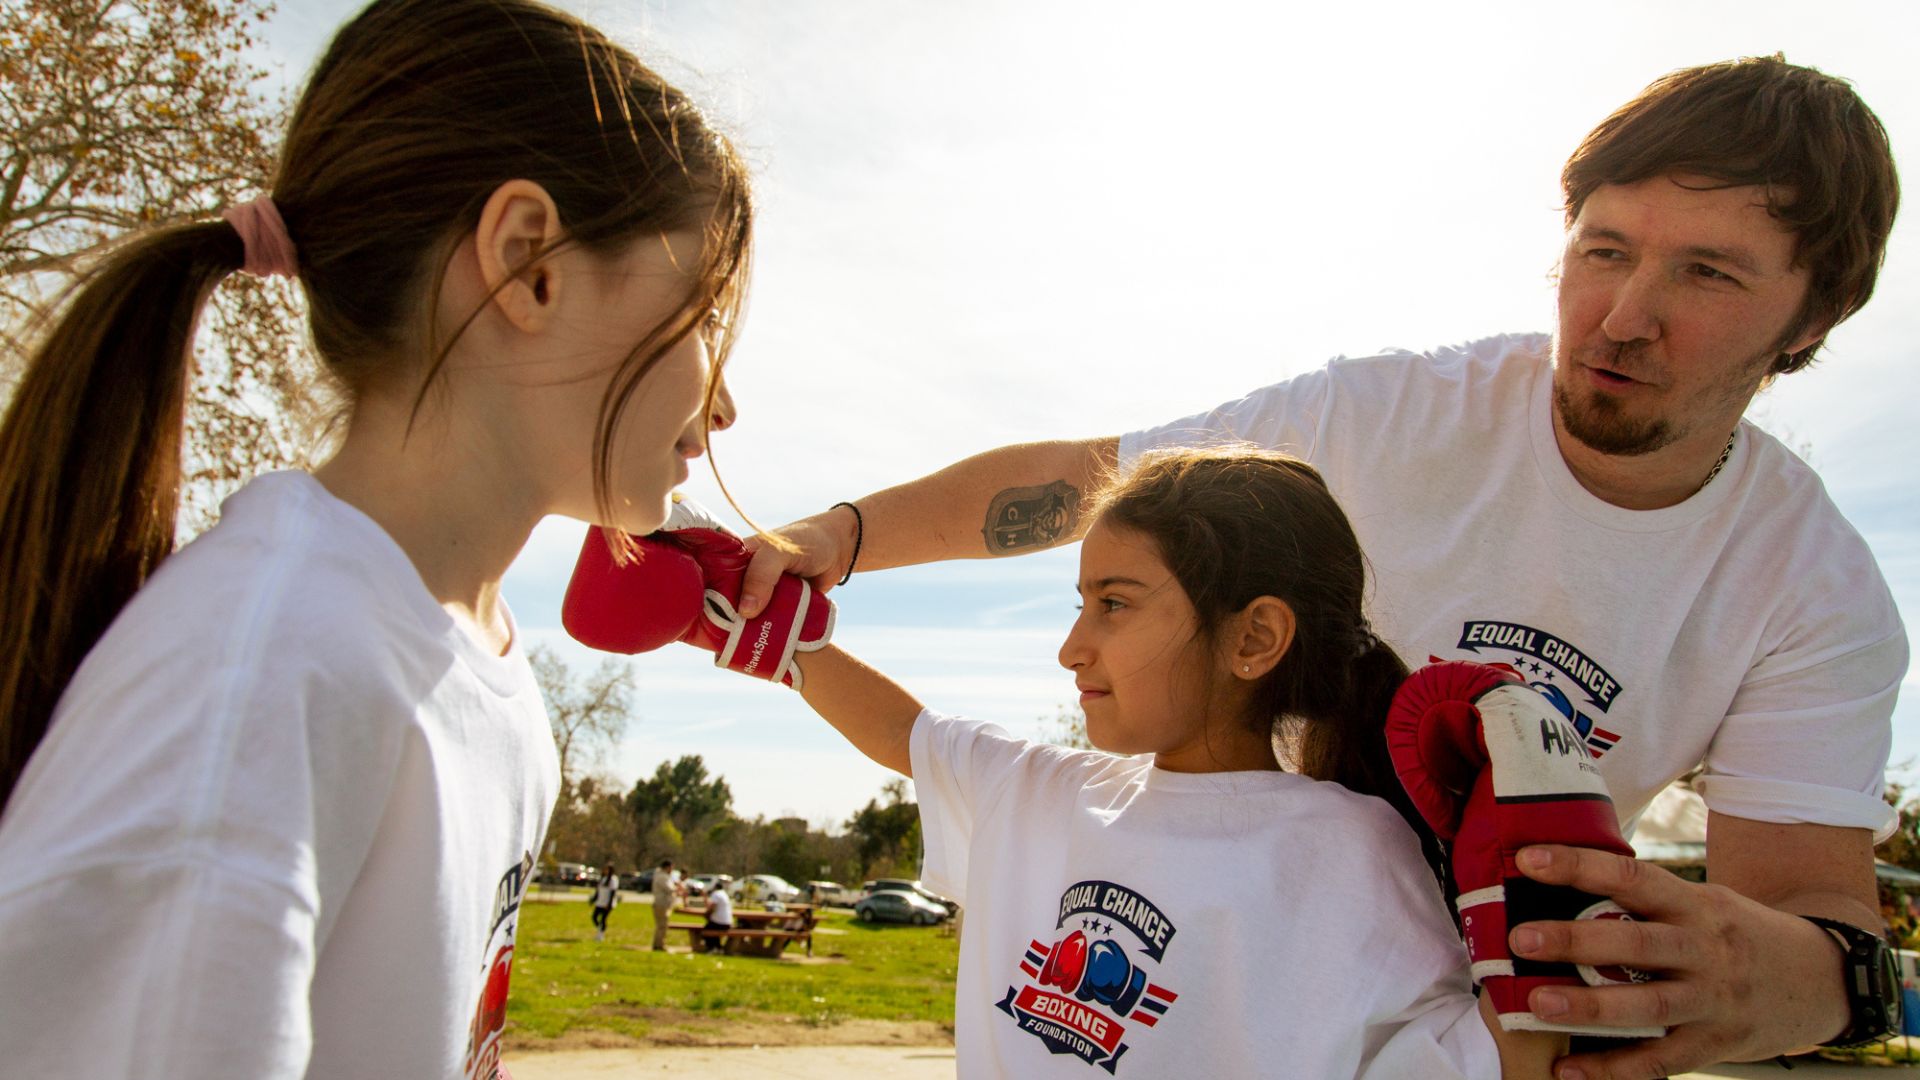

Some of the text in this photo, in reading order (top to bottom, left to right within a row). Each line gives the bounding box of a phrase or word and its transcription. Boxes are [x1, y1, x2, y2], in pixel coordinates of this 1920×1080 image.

[1466, 623, 1616, 704] EQUAL CHANCE
[1061, 884, 1170, 950] EQUAL CHANCE
[1025, 1018, 1094, 1058] FOUNDATION
[1030, 994, 1109, 1041] BOXING
